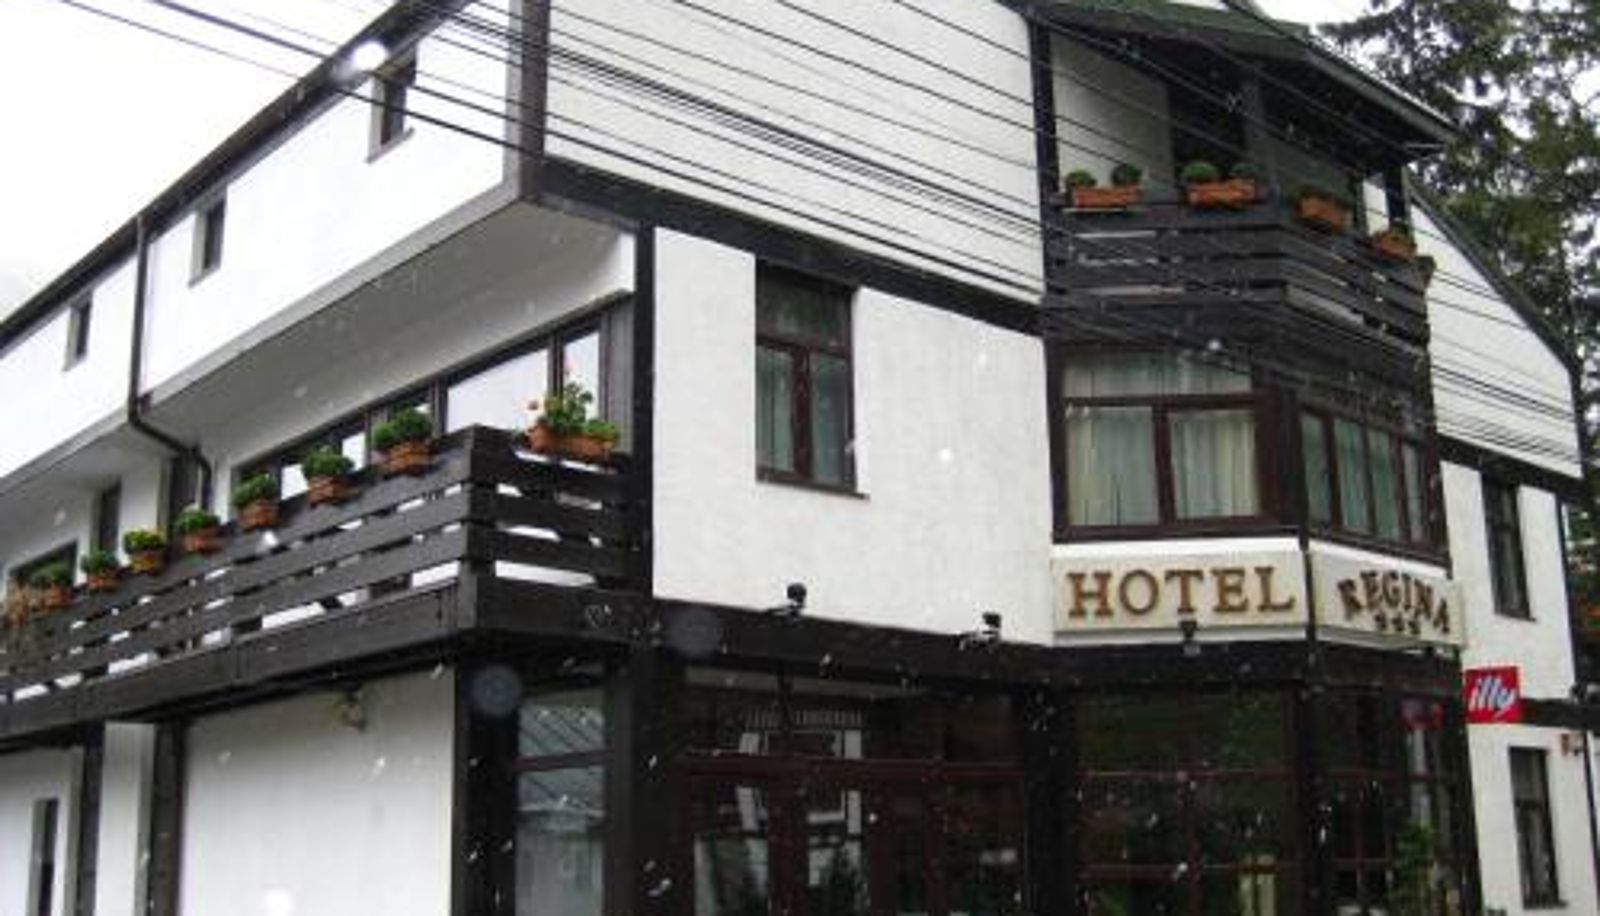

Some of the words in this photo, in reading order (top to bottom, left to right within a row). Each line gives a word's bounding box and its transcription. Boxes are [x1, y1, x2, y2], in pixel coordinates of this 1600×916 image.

[1066, 566, 1297, 618] HOTEL
[1337, 569, 1450, 633] REGINA
[1468, 676, 1516, 719] illy
